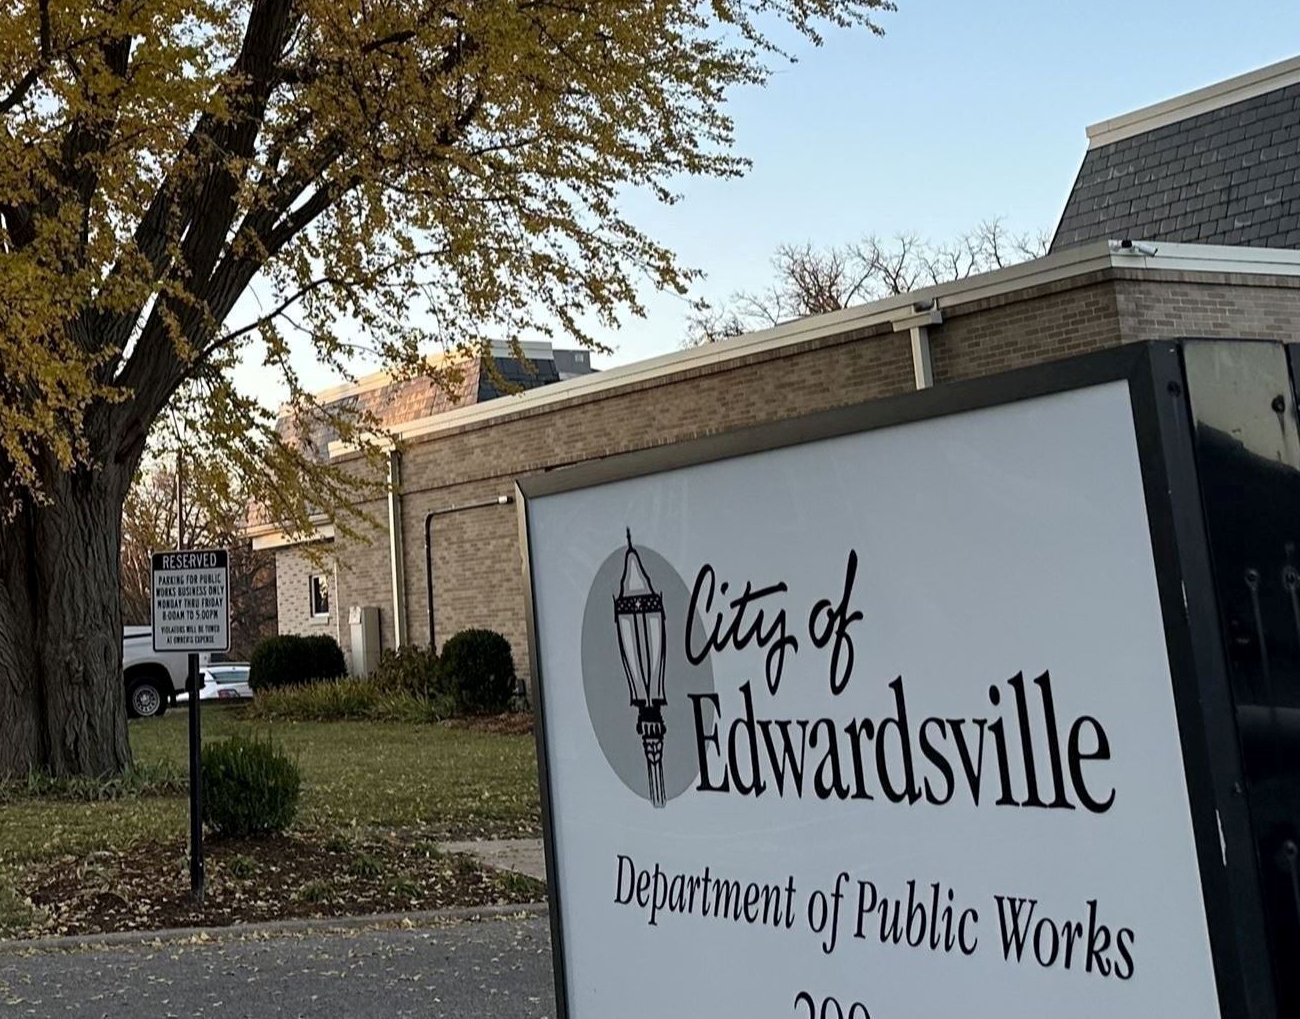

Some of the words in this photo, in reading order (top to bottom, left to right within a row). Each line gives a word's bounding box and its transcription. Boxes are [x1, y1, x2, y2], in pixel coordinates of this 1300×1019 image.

[162, 553, 217, 569] RESERVED
[158, 575, 184, 585] PARKING
[186, 574, 198, 584] FOR
[200, 573, 221, 584] PUBLIC
[156, 587, 175, 597] WORKS
[178, 586, 206, 596] BUSINESS
[208, 585, 224, 595] ONLY
[157, 599, 182, 609] MONDAY
[184, 598, 200, 608] THRU
[202, 597, 223, 607] FRIDAY
[187, 610, 194, 620] TO
[685, 564, 798, 696] City
[809, 549, 864, 696] of
[687, 670, 1116, 814] Edwardsville
[614, 854, 797, 929] Department
[807, 872, 850, 955] of
[853, 880, 979, 956] Public
[993, 895, 1135, 980] Works
